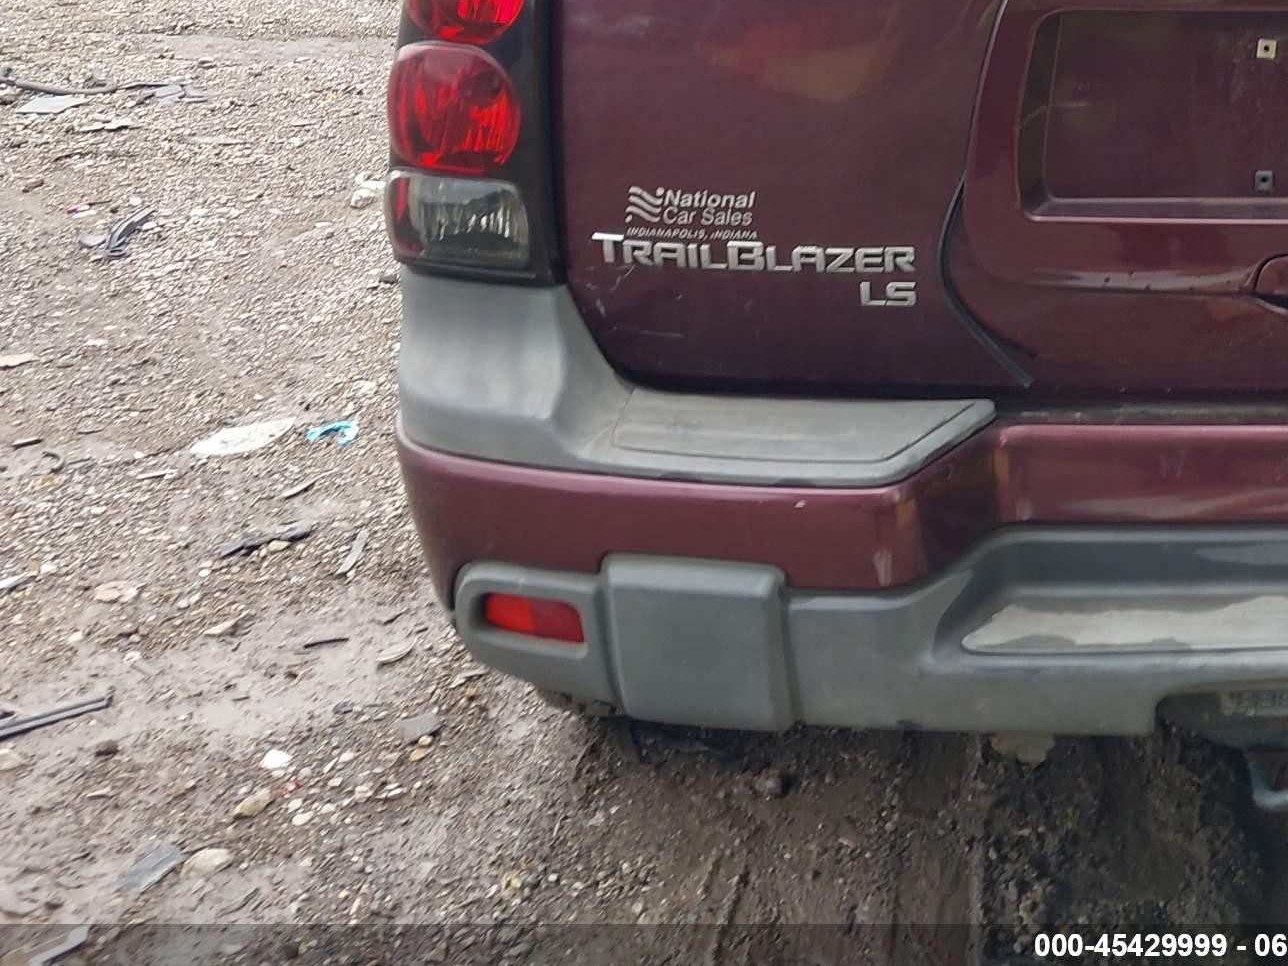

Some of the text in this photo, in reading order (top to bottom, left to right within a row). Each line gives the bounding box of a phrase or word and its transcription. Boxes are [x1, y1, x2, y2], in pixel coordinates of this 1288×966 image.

[663, 189, 756, 209] National
[662, 206, 753, 226] Car Sales
[626, 227, 758, 240] INDIANAPOLIS, INDIANA
[591, 232, 916, 274] TRAILBLAZER
[859, 281, 917, 307] LS
